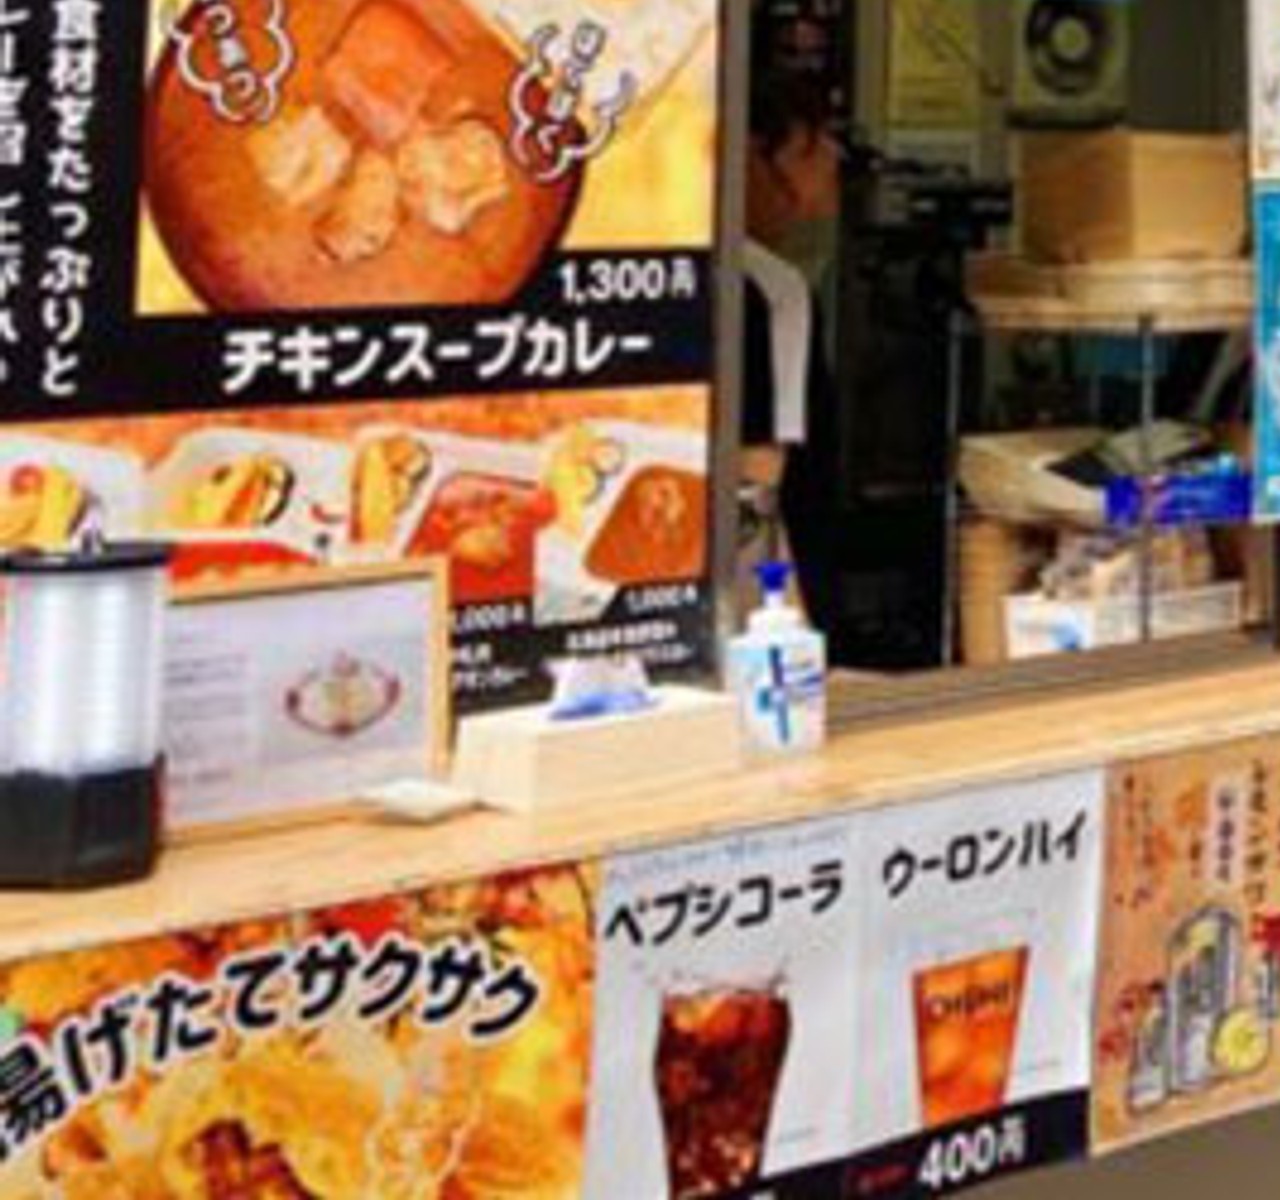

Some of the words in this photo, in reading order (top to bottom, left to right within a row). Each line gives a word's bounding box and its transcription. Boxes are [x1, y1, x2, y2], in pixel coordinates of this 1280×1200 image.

[222, 314, 653, 394] チキンスープカレー
[883, 809, 1087, 900] ウーロンハイ
[604, 858, 843, 948] ペプシコーラ
